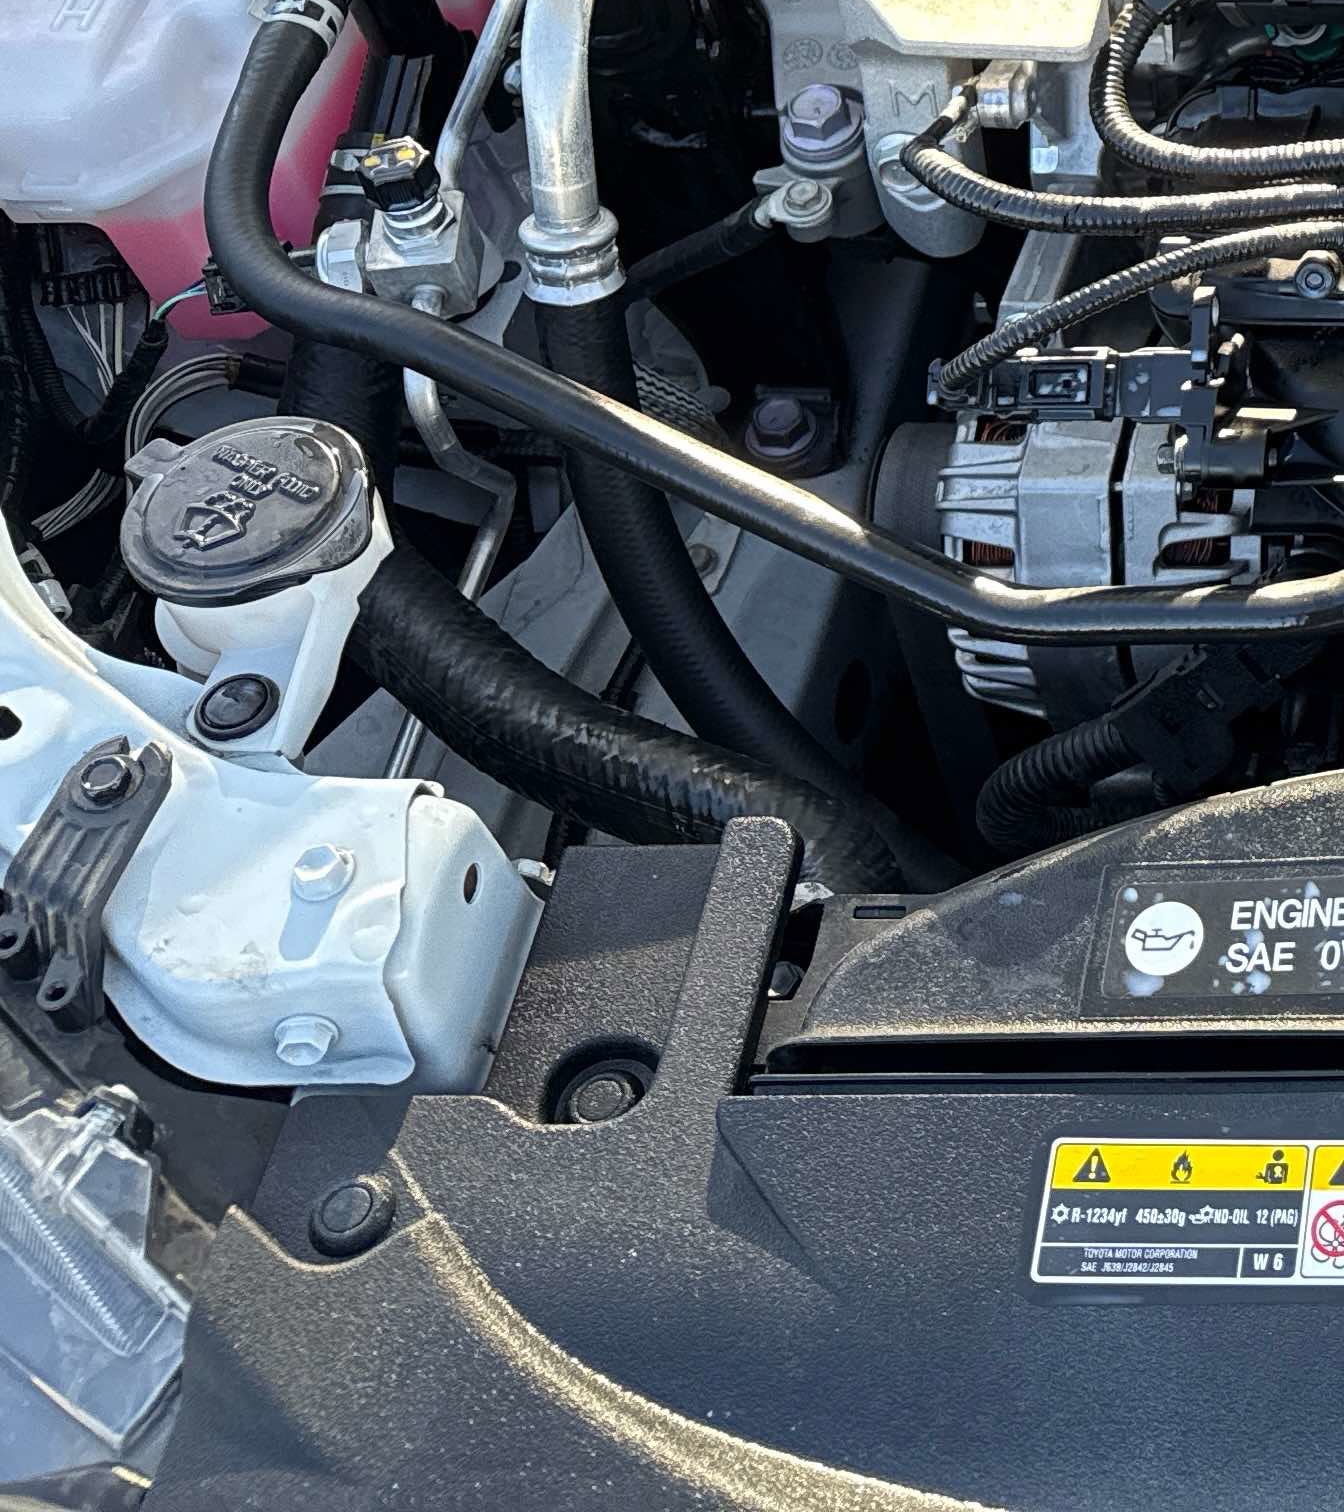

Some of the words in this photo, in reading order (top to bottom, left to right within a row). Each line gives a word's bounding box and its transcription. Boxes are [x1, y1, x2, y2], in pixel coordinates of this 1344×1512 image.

[1225, 941, 1297, 973] SAE
[1071, 1207, 1127, 1226] R-1234yf
[1213, 1208, 1250, 1225] ND-OIL
[1256, 1209, 1268, 1224] 12
[1270, 1208, 1299, 1227] (PAG)
[1084, 1248, 1113, 1258] TOYOTA
[1114, 1248, 1142, 1259] MOTOR
[1144, 1248, 1198, 1259] CORPORATION
[1253, 1253, 1271, 1270] W
[1273, 1253, 1284, 1271] 6
[1080, 1262, 1097, 1272] SAE
